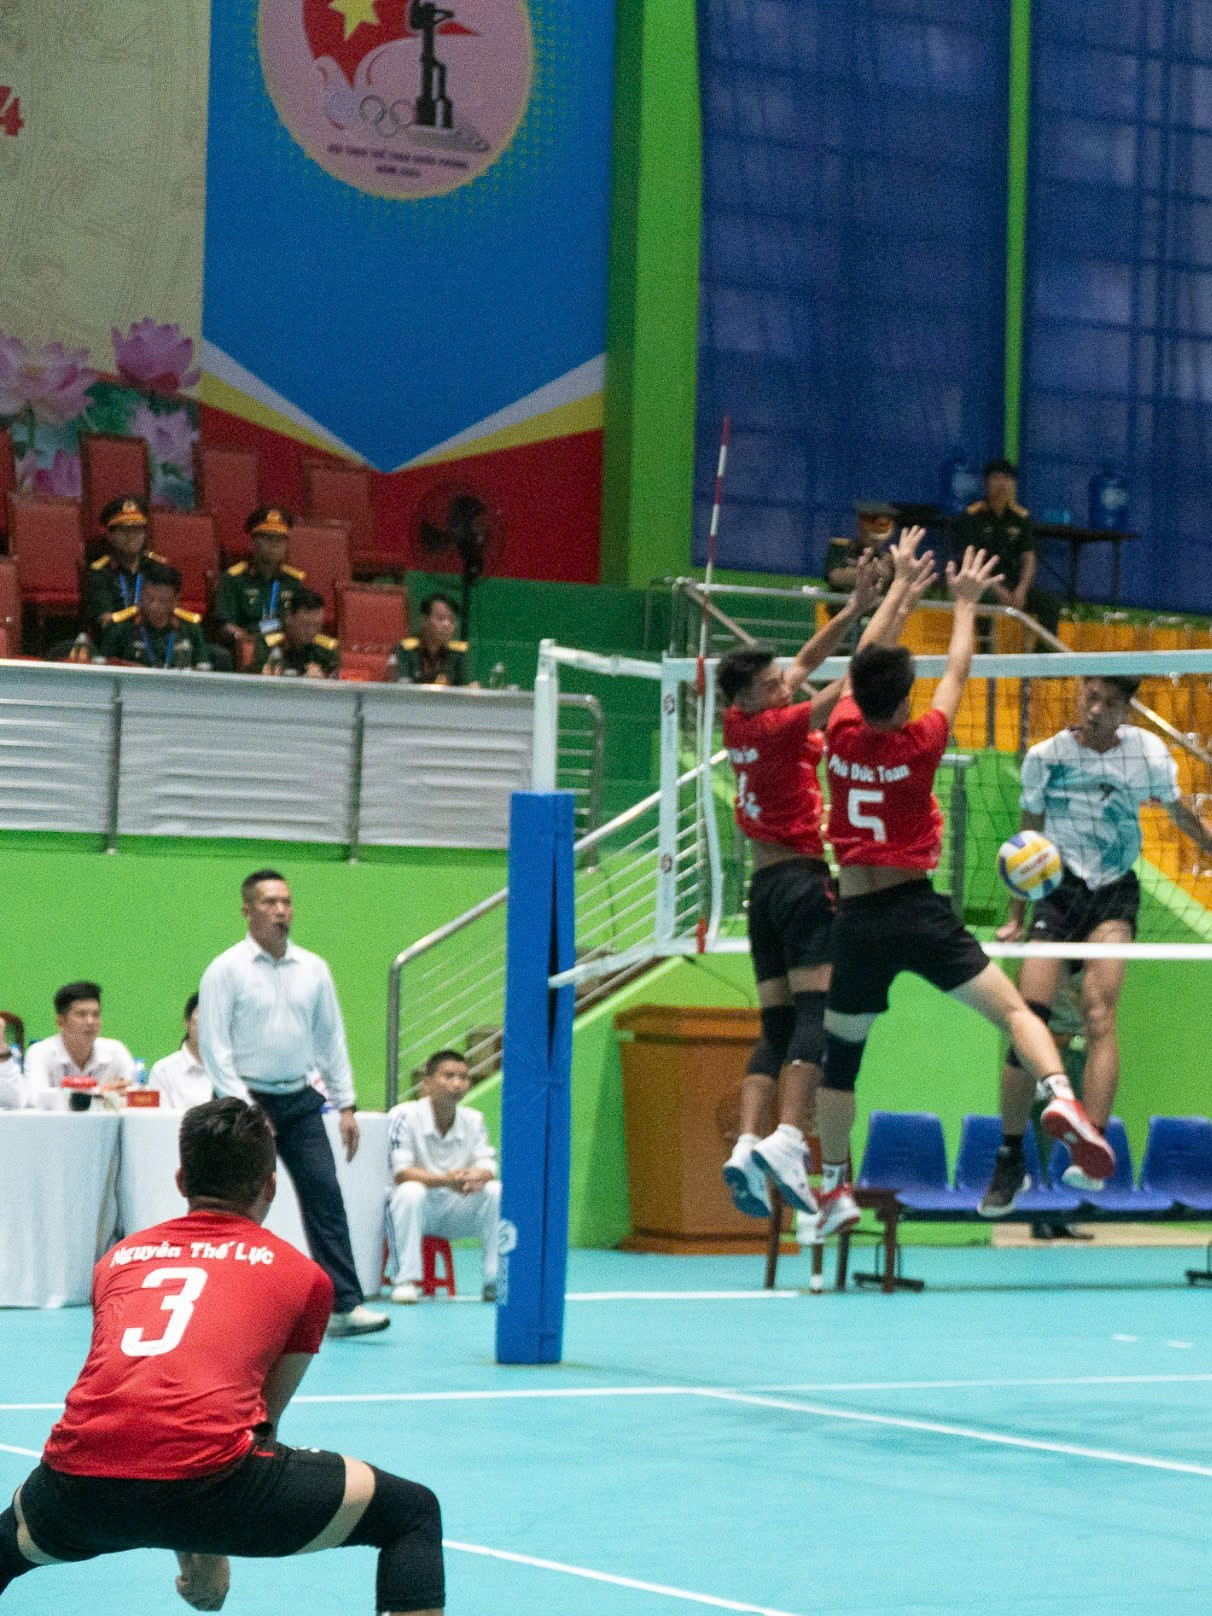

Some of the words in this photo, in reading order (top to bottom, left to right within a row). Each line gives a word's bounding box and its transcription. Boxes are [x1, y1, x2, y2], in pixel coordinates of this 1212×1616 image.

[847, 788, 888, 844] 5
[190, 1240, 236, 1260] Thế
[235, 1242, 275, 1266] Lực
[120, 1266, 208, 1357] 3
